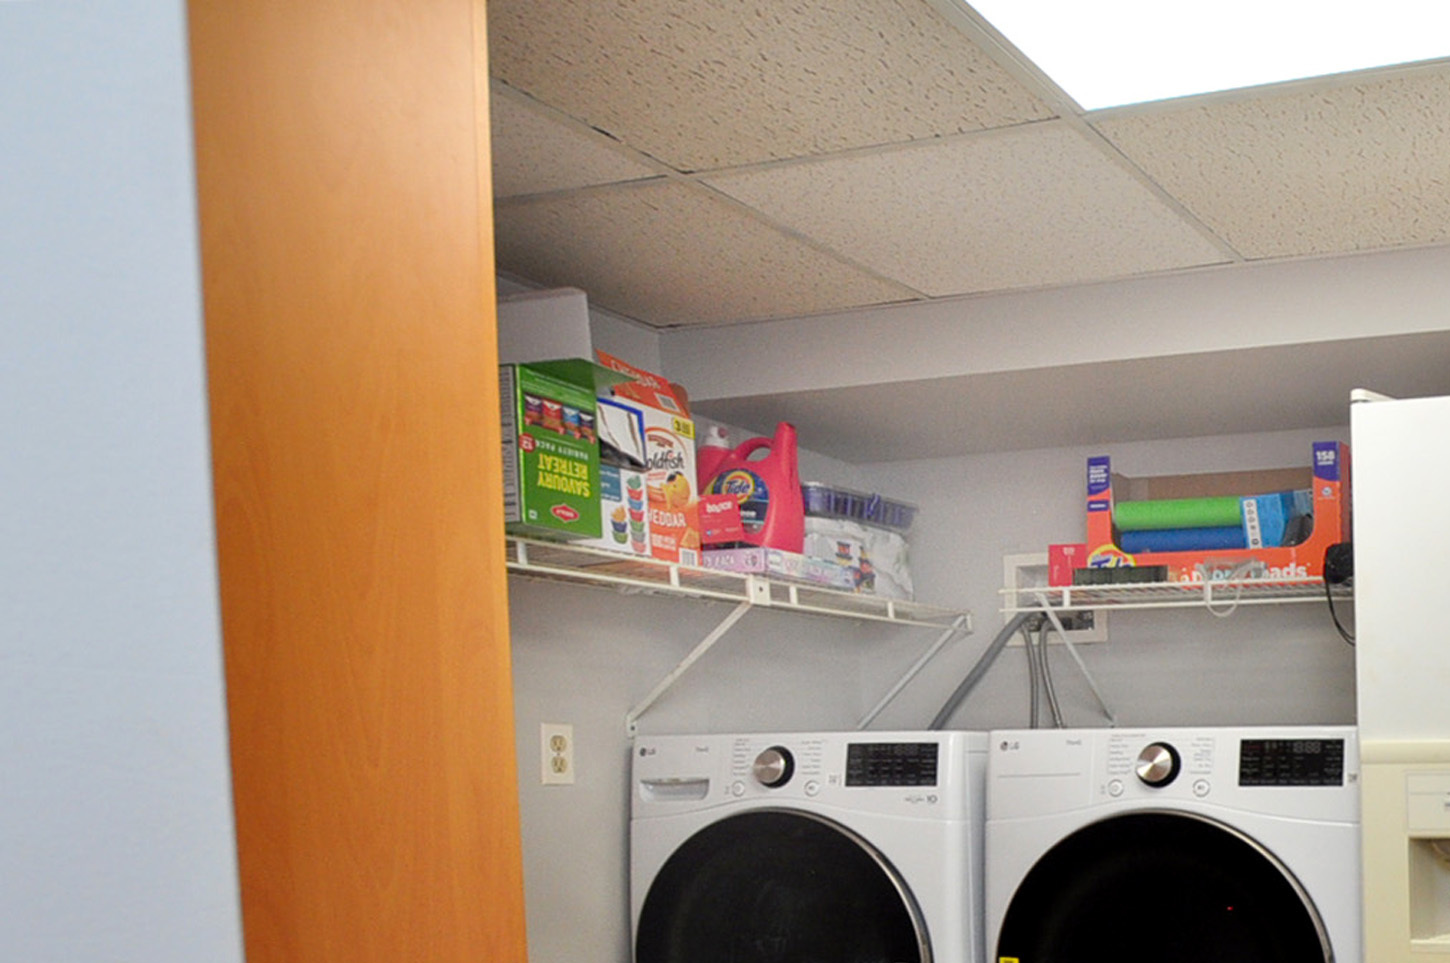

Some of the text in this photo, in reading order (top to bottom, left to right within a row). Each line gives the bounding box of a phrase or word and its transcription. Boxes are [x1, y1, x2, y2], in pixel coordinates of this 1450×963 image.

[537, 453, 588, 480] RETREAT
[645, 450, 685, 470] oldfish
[537, 471, 591, 498] SAVOURY
[726, 479, 751, 494] Tide
